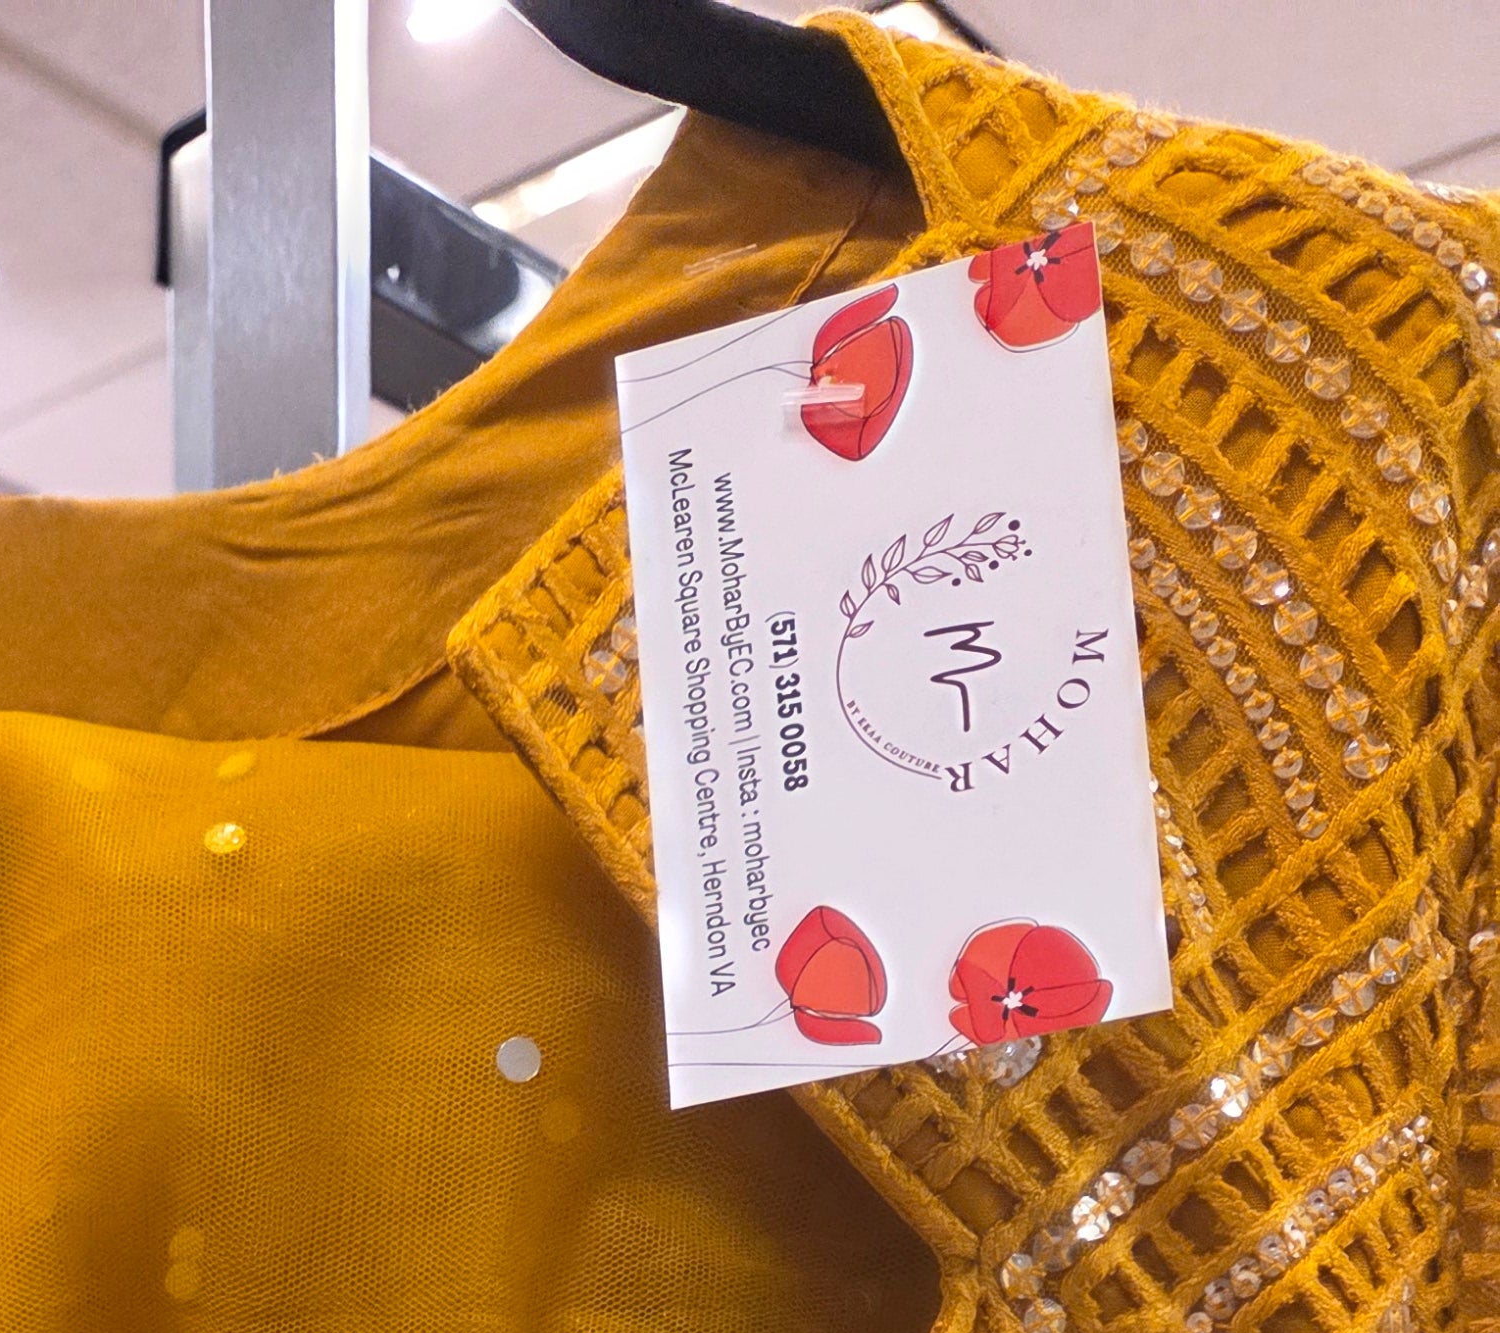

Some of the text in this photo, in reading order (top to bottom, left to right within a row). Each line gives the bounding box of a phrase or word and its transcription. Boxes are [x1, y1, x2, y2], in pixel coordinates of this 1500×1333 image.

[713, 472, 755, 733] www.MoharByEC.com
[668, 448, 737, 997] McLearen Square Shopping Centre, Herndon VA
[736, 746, 763, 807] Insta
[764, 611, 809, 791] (571) 315 0058
[846, 700, 860, 715] BY
[883, 742, 941, 773] COUTURE
[945, 628, 1109, 792] MOHAR
[743, 821, 774, 952] moharbyec
